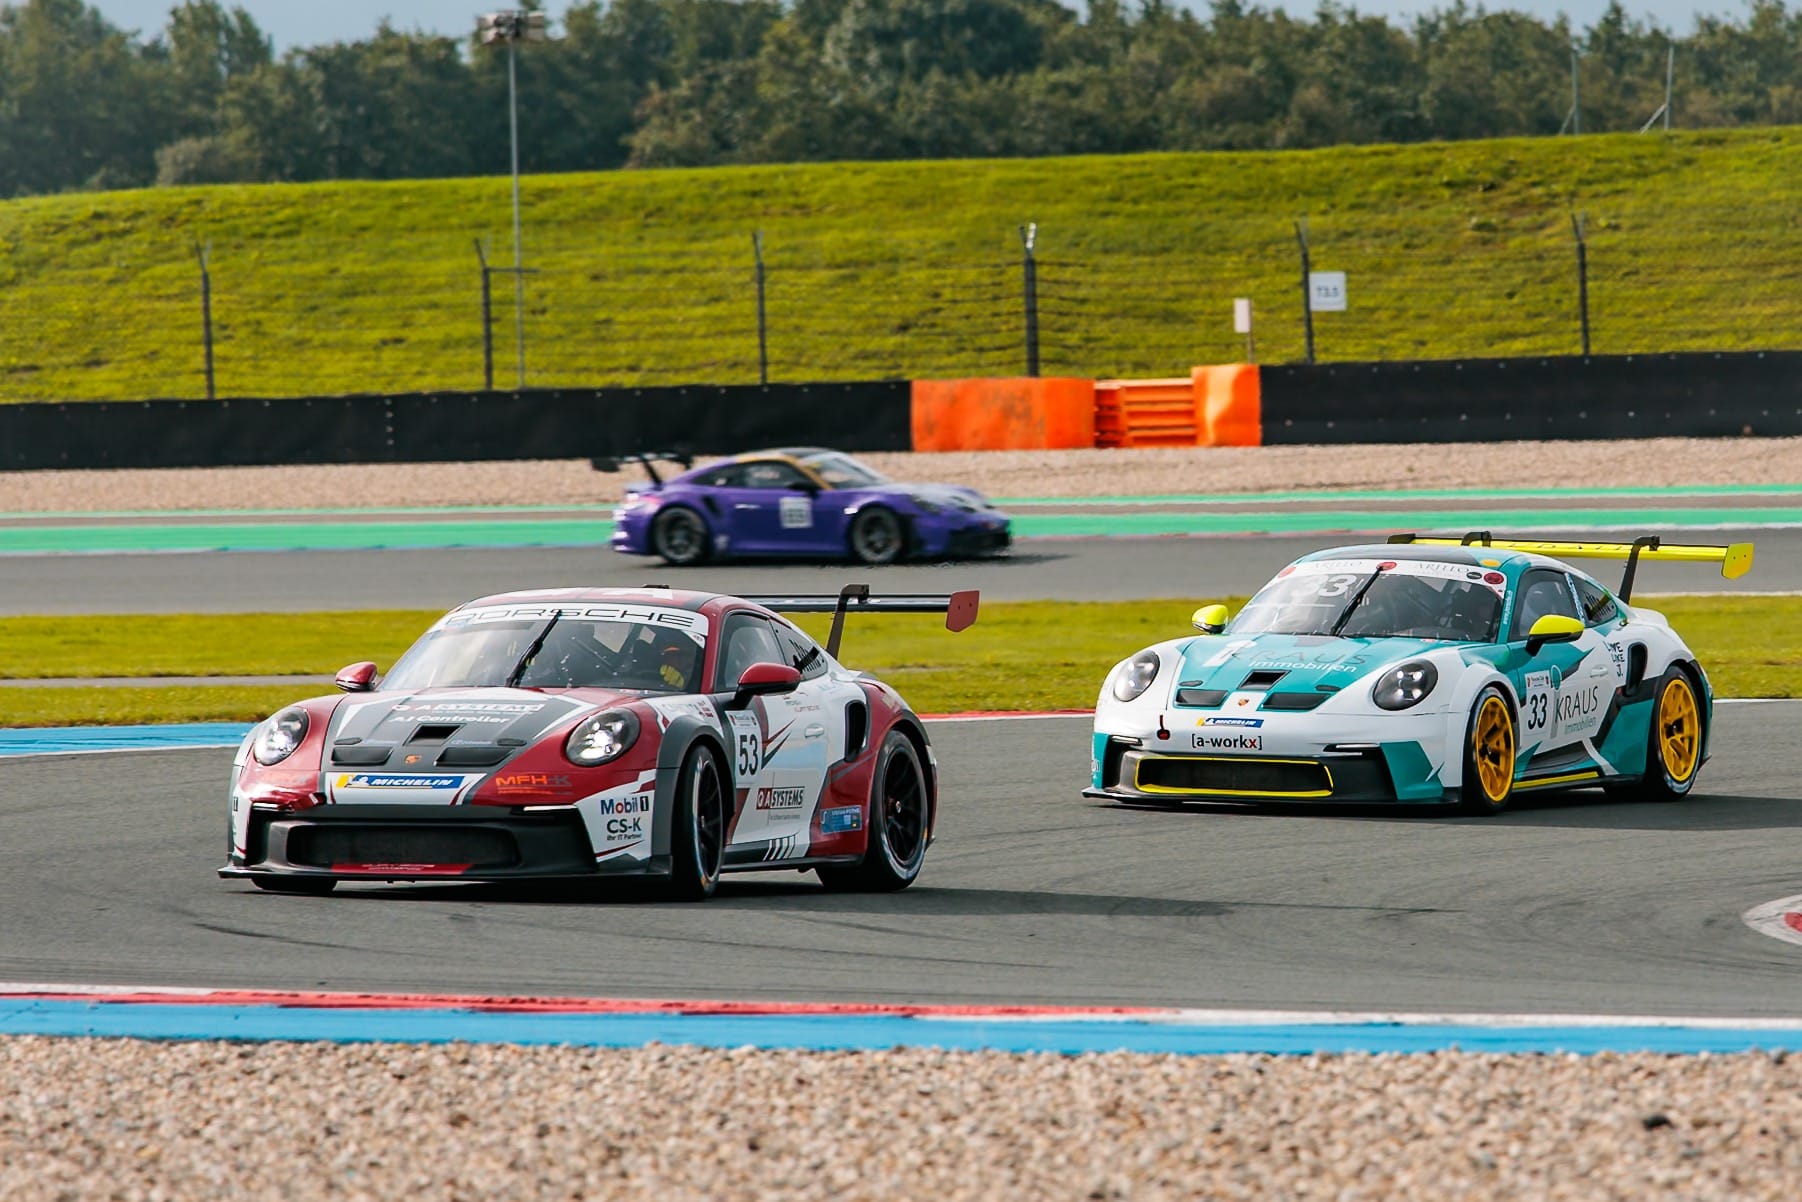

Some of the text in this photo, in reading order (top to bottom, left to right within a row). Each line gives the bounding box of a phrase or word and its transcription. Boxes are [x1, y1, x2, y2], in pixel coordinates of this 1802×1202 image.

[447, 608, 695, 628] PORSCHE
[1528, 692, 1548, 730] 33
[1555, 685, 1599, 724] KRAUS
[415, 715, 511, 723] Controller
[1191, 733, 1263, 750] [a-workx]
[739, 734, 758, 776] 53
[371, 778, 454, 787] MICHELIN
[600, 796, 650, 815] Mobil 1
[771, 789, 804, 807] SYSTEMS
[607, 817, 642, 834] CS-K
